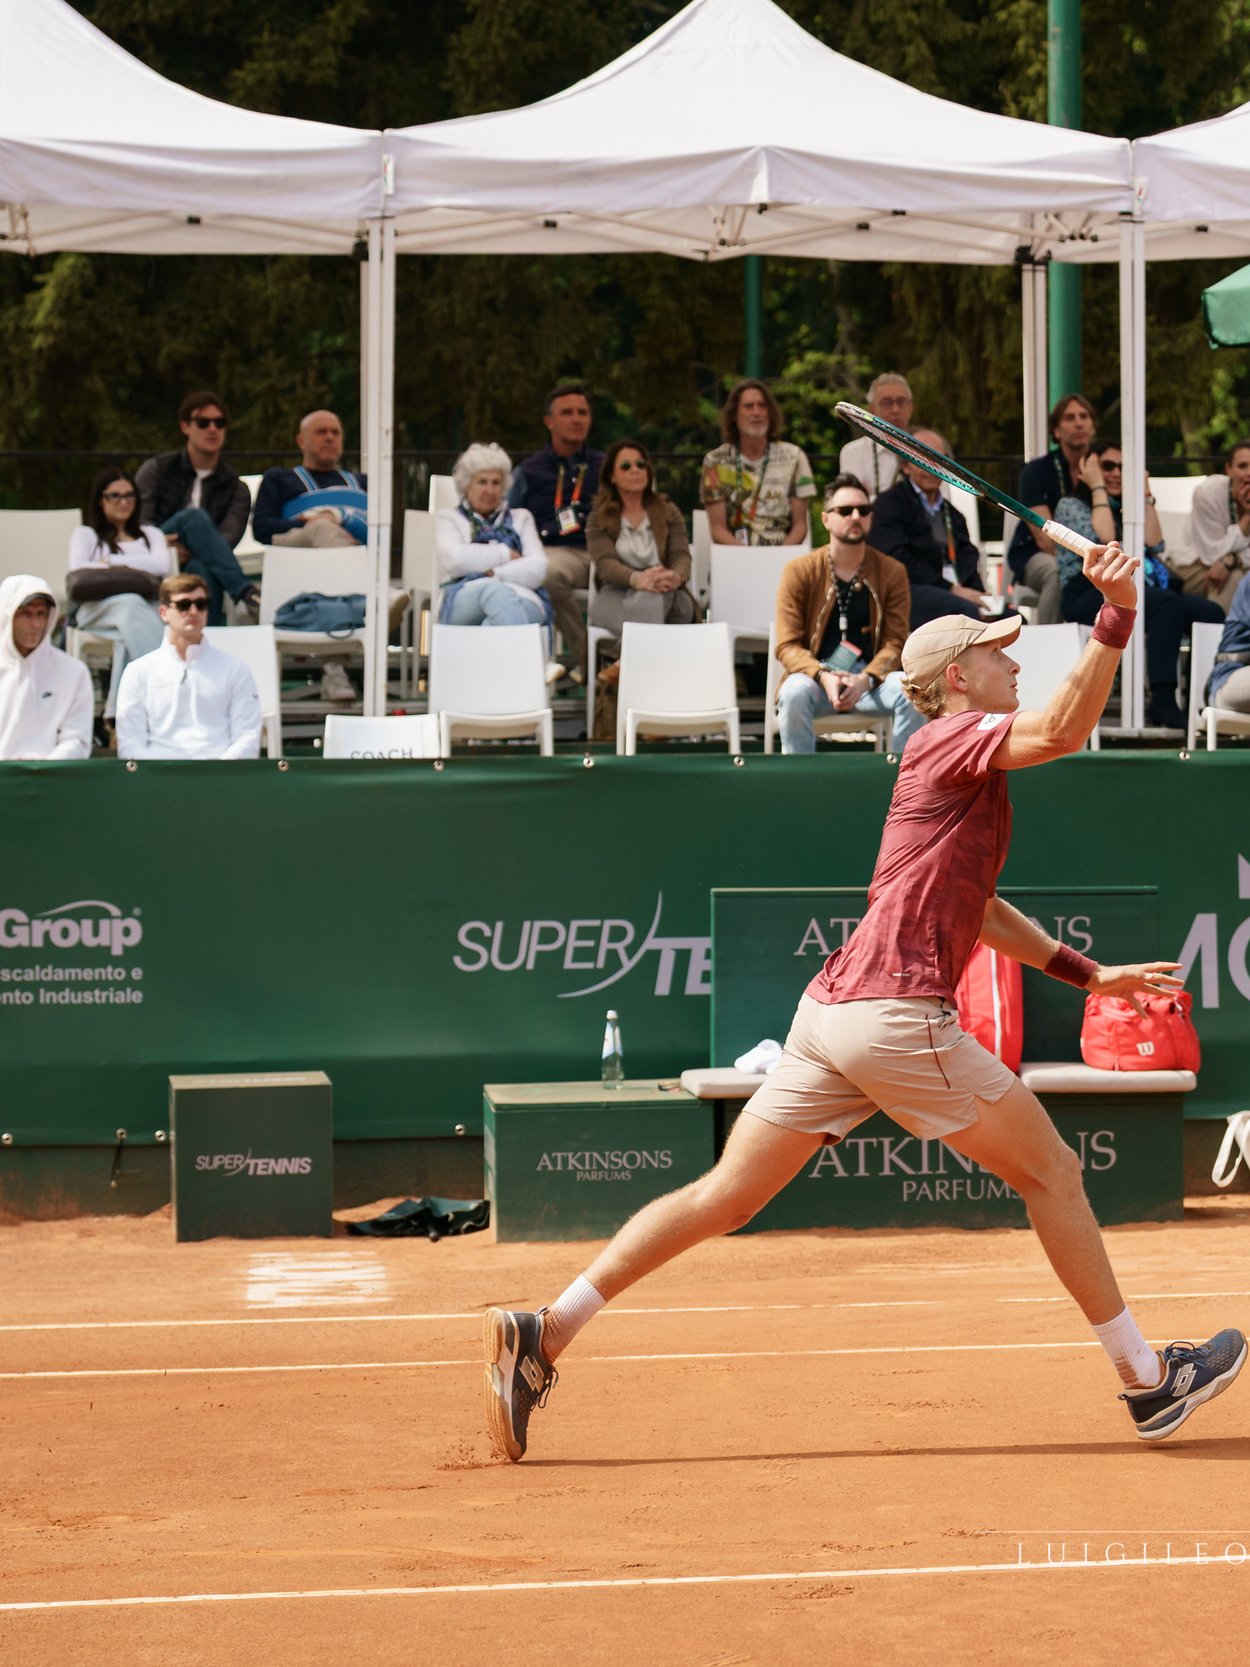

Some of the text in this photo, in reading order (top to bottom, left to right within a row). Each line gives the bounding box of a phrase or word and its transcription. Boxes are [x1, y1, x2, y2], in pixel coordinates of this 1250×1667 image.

[0, 907, 142, 956] Group
[131, 967, 143, 980] e
[39, 986, 143, 1004] Industriale
[247, 1156, 312, 1175] TENNIS
[536, 1150, 673, 1171] ATKINSONS
[576, 1169, 632, 1182] PARFUMS
